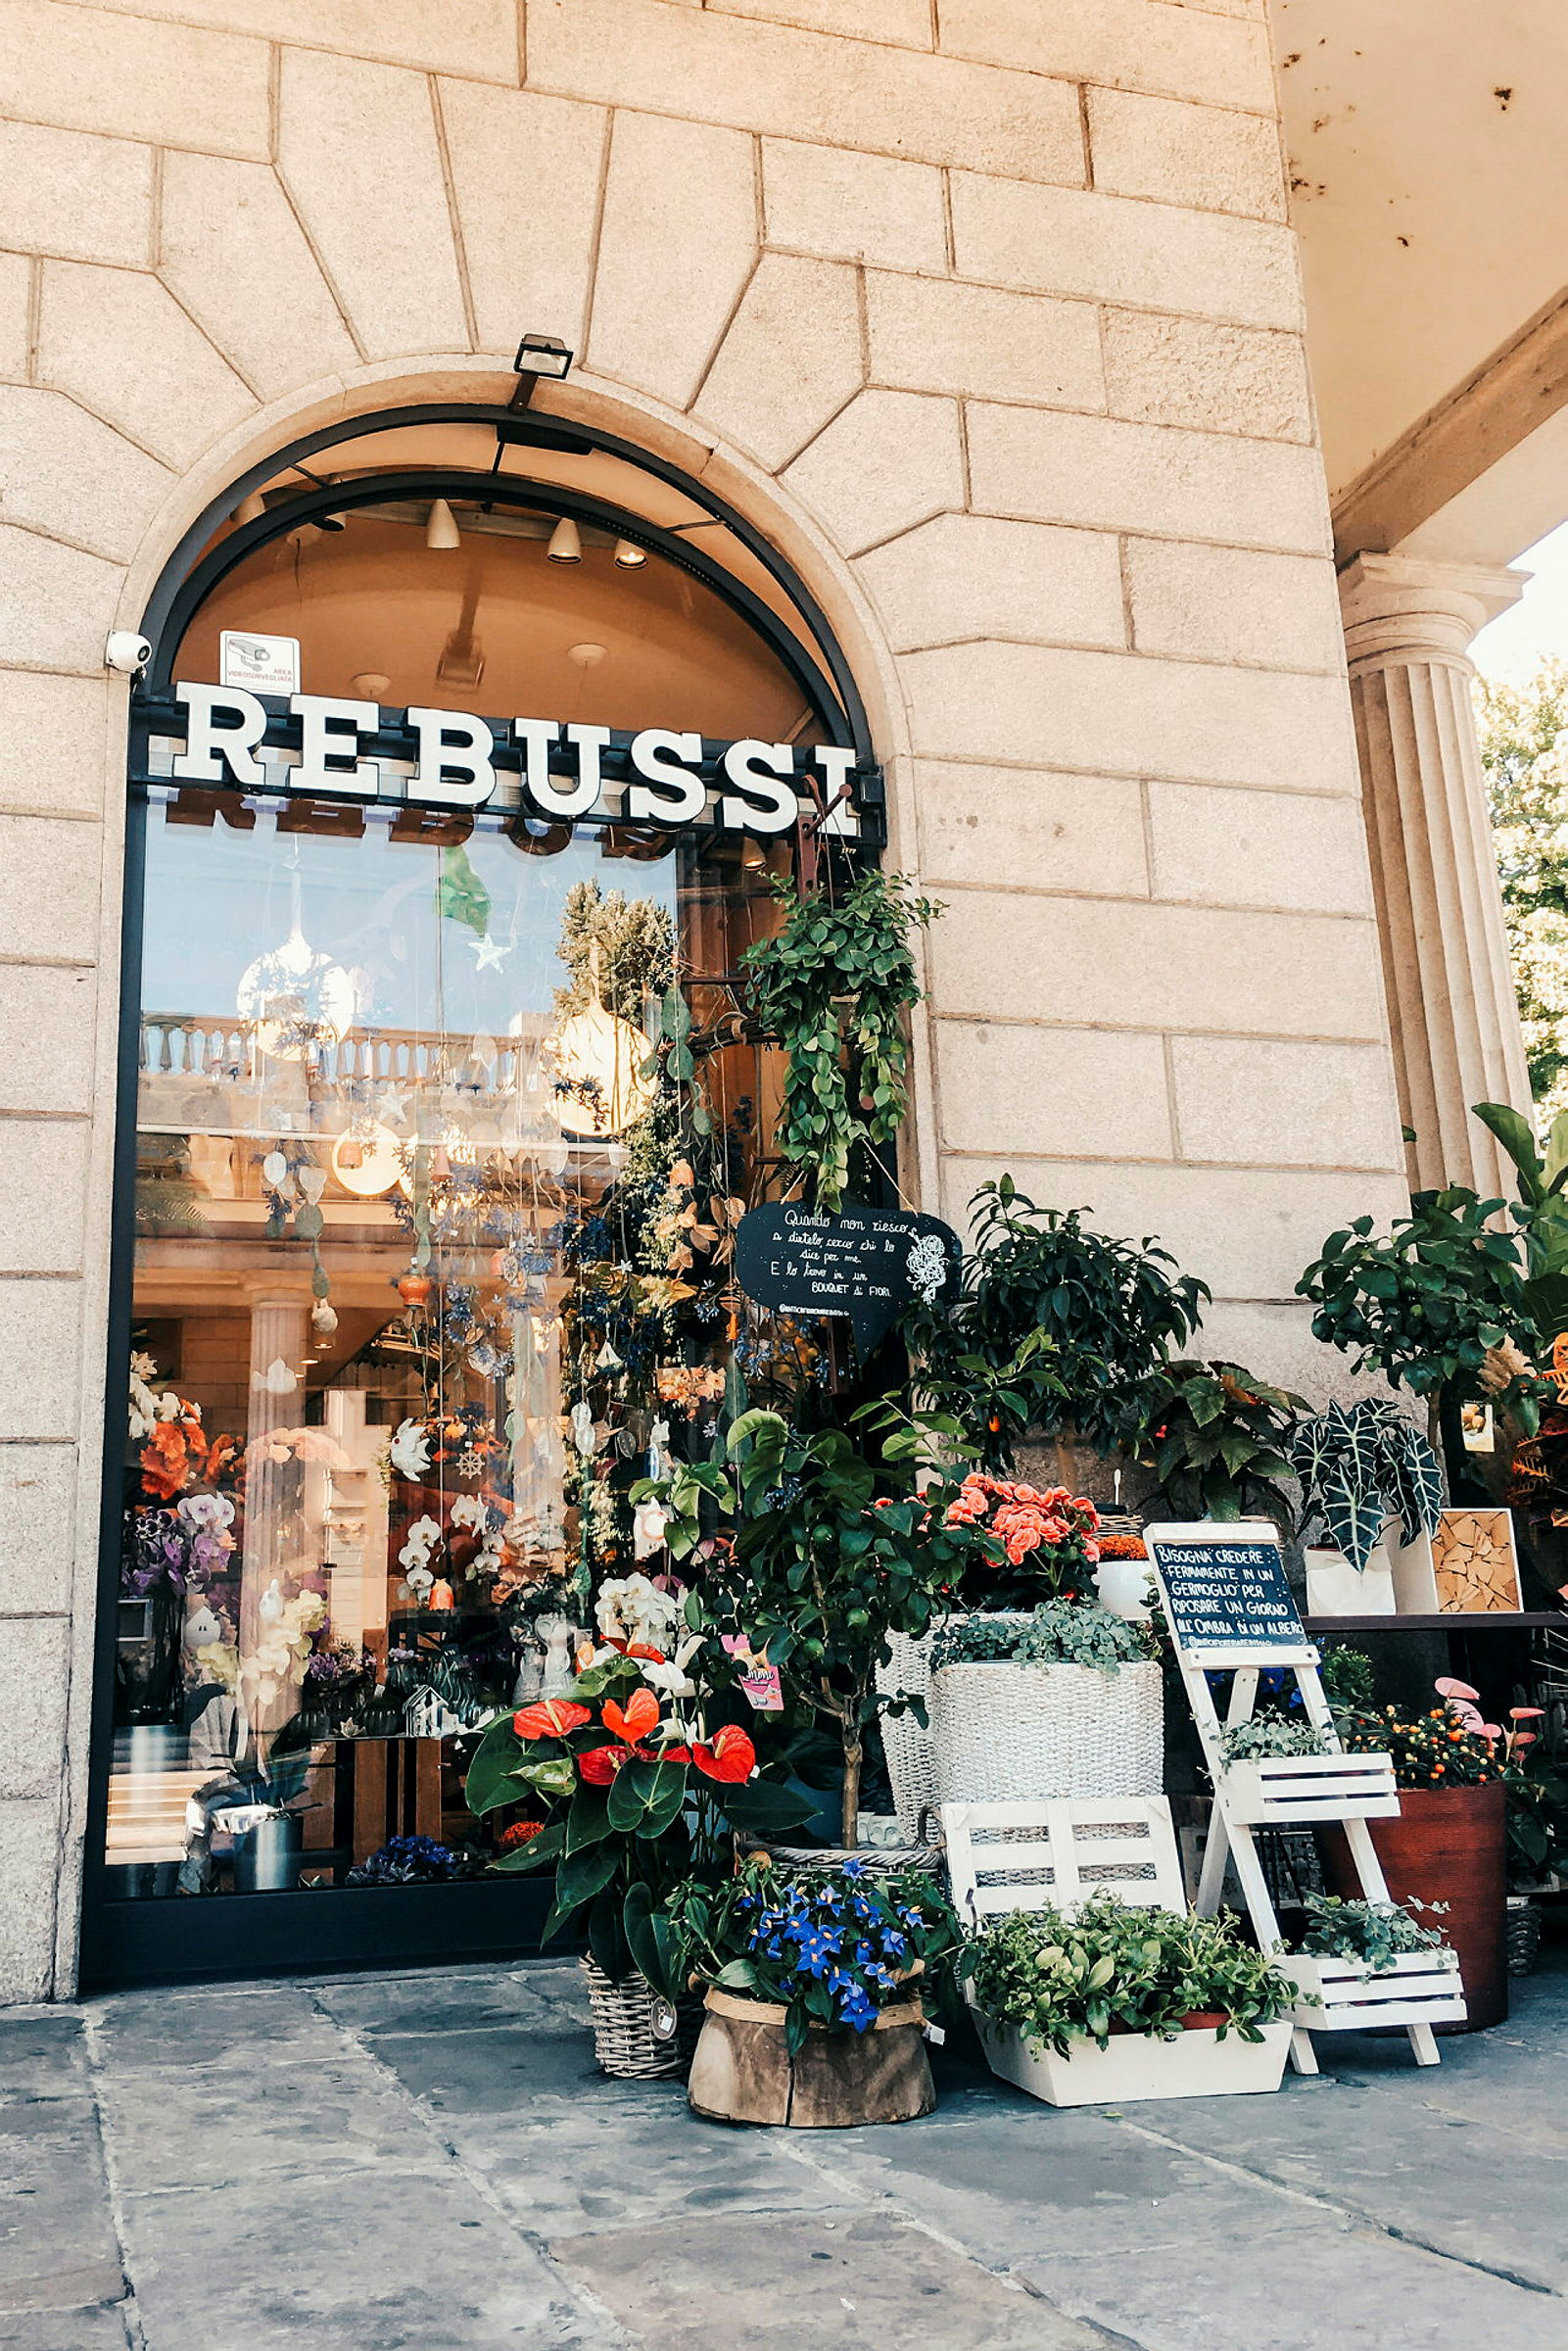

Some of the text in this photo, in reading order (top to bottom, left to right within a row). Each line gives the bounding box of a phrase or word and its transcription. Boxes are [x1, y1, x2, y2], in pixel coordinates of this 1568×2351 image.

[173, 681, 861, 836] REBUSSI
[784, 1210, 831, 1227] Quando
[839, 1219, 866, 1230] non
[859, 1239, 877, 1251] chi
[883, 1239, 896, 1253] lo
[799, 1249, 821, 1261] dice
[771, 1261, 781, 1275] E
[785, 1261, 798, 1276] lo
[811, 1281, 850, 1293] BOUQUET
[1156, 1545, 1265, 1564] BISOGNA CREDERE
[1166, 1565, 1274, 1582] FERMAMENTE IN UN
[1171, 1581, 1238, 1597] GERMOGLIO
[1171, 1598, 1289, 1616] RIPOSARE UN GIORNO
[1249, 1622, 1265, 1636] UN
[1266, 1620, 1305, 1636] ALBERO
